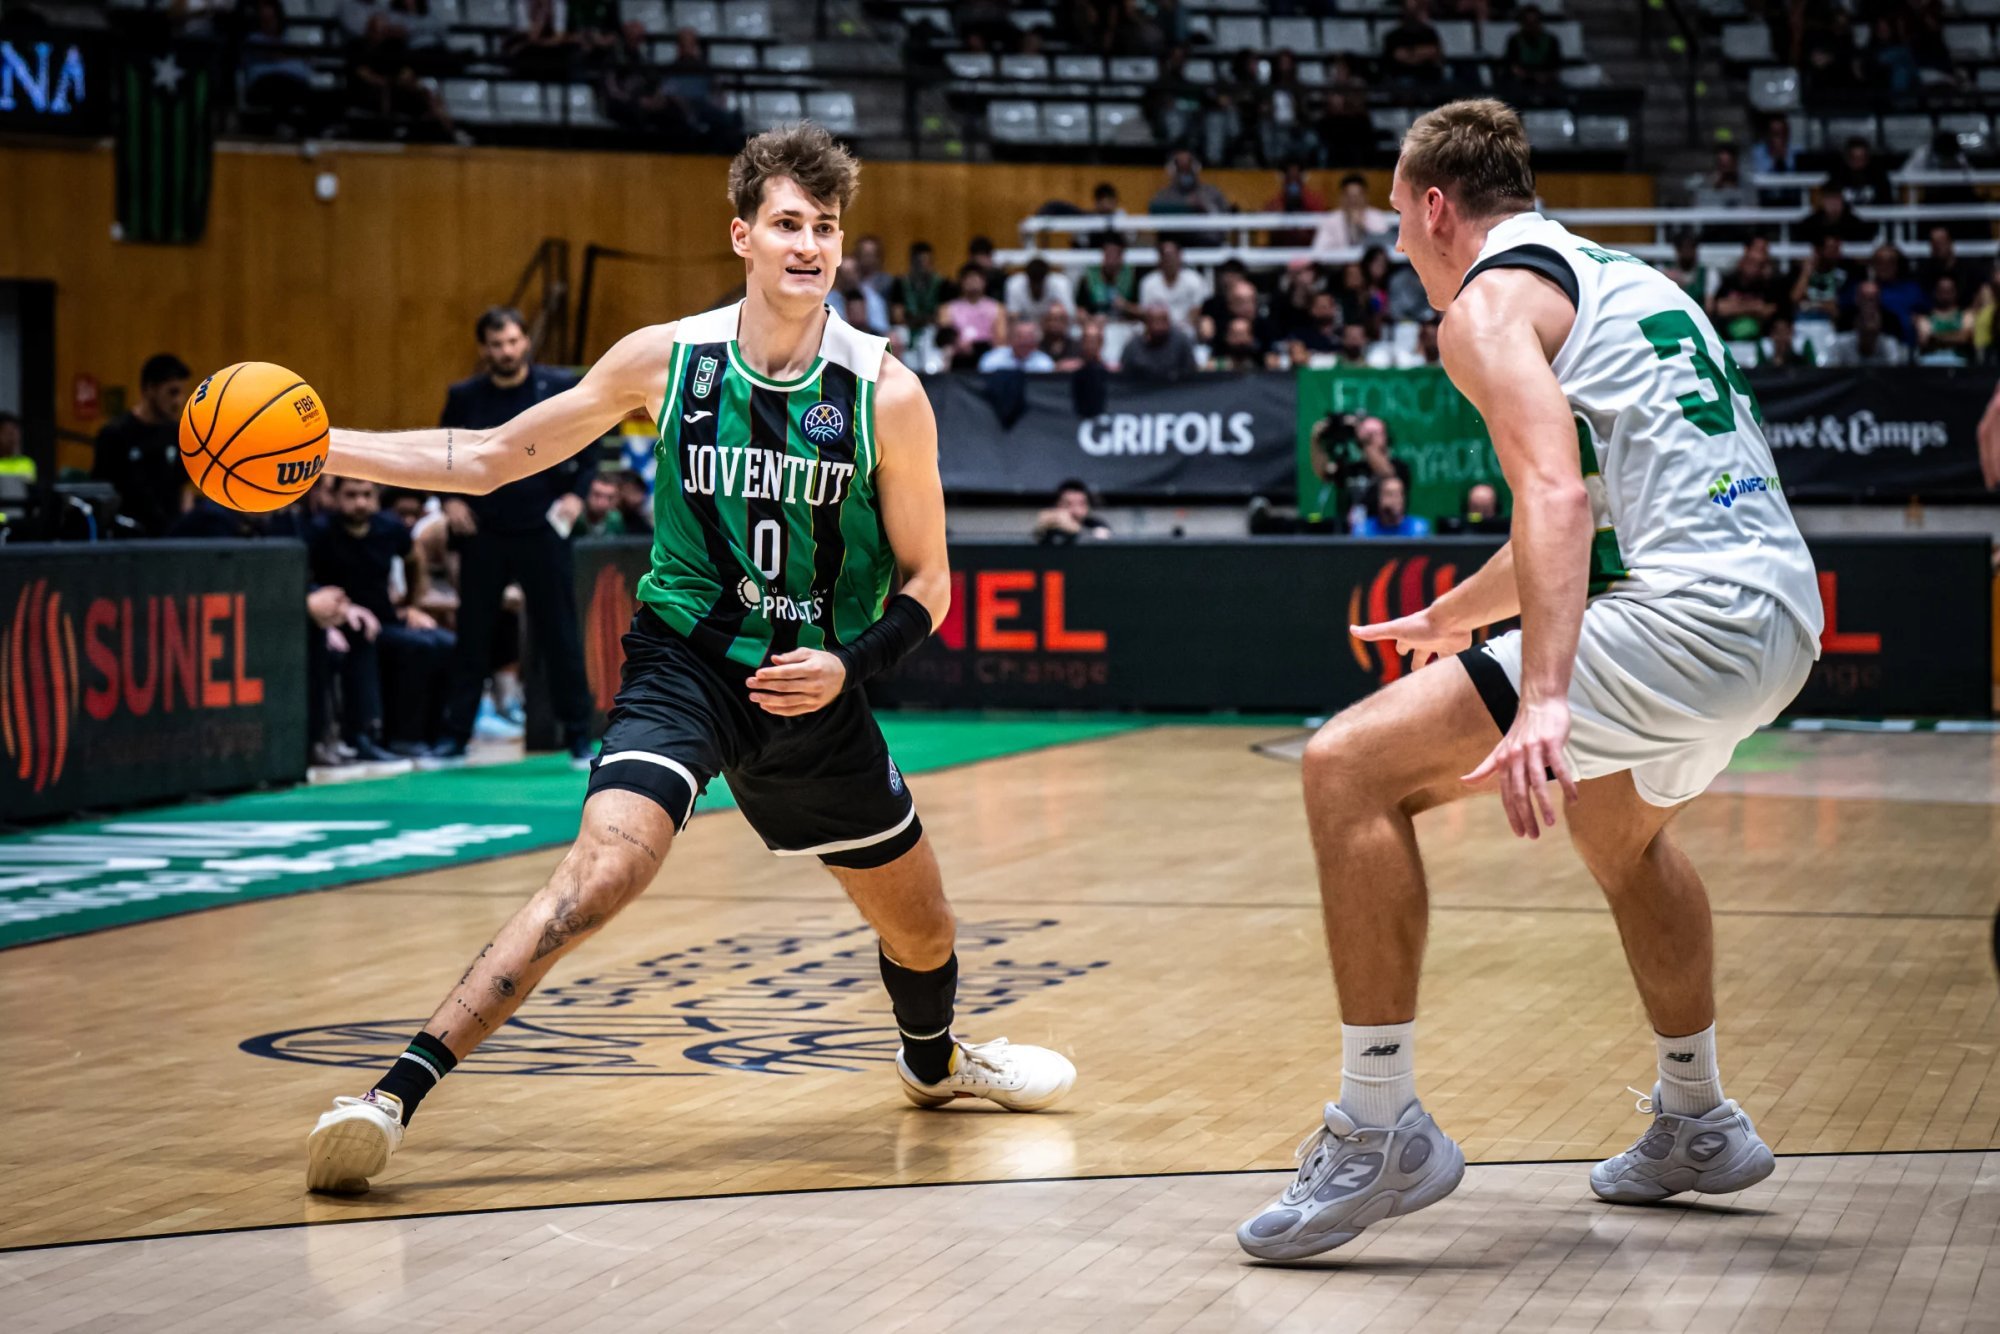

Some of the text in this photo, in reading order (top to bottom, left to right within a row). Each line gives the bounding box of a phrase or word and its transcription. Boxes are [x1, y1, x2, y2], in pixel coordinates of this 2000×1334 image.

[293, 395, 317, 416] FIBA
[1078, 412, 1255, 456] GRIFOLS
[684, 444, 856, 507] JOVENTUT
[754, 519, 781, 580] 0
[84, 594, 264, 721] SUNEL
